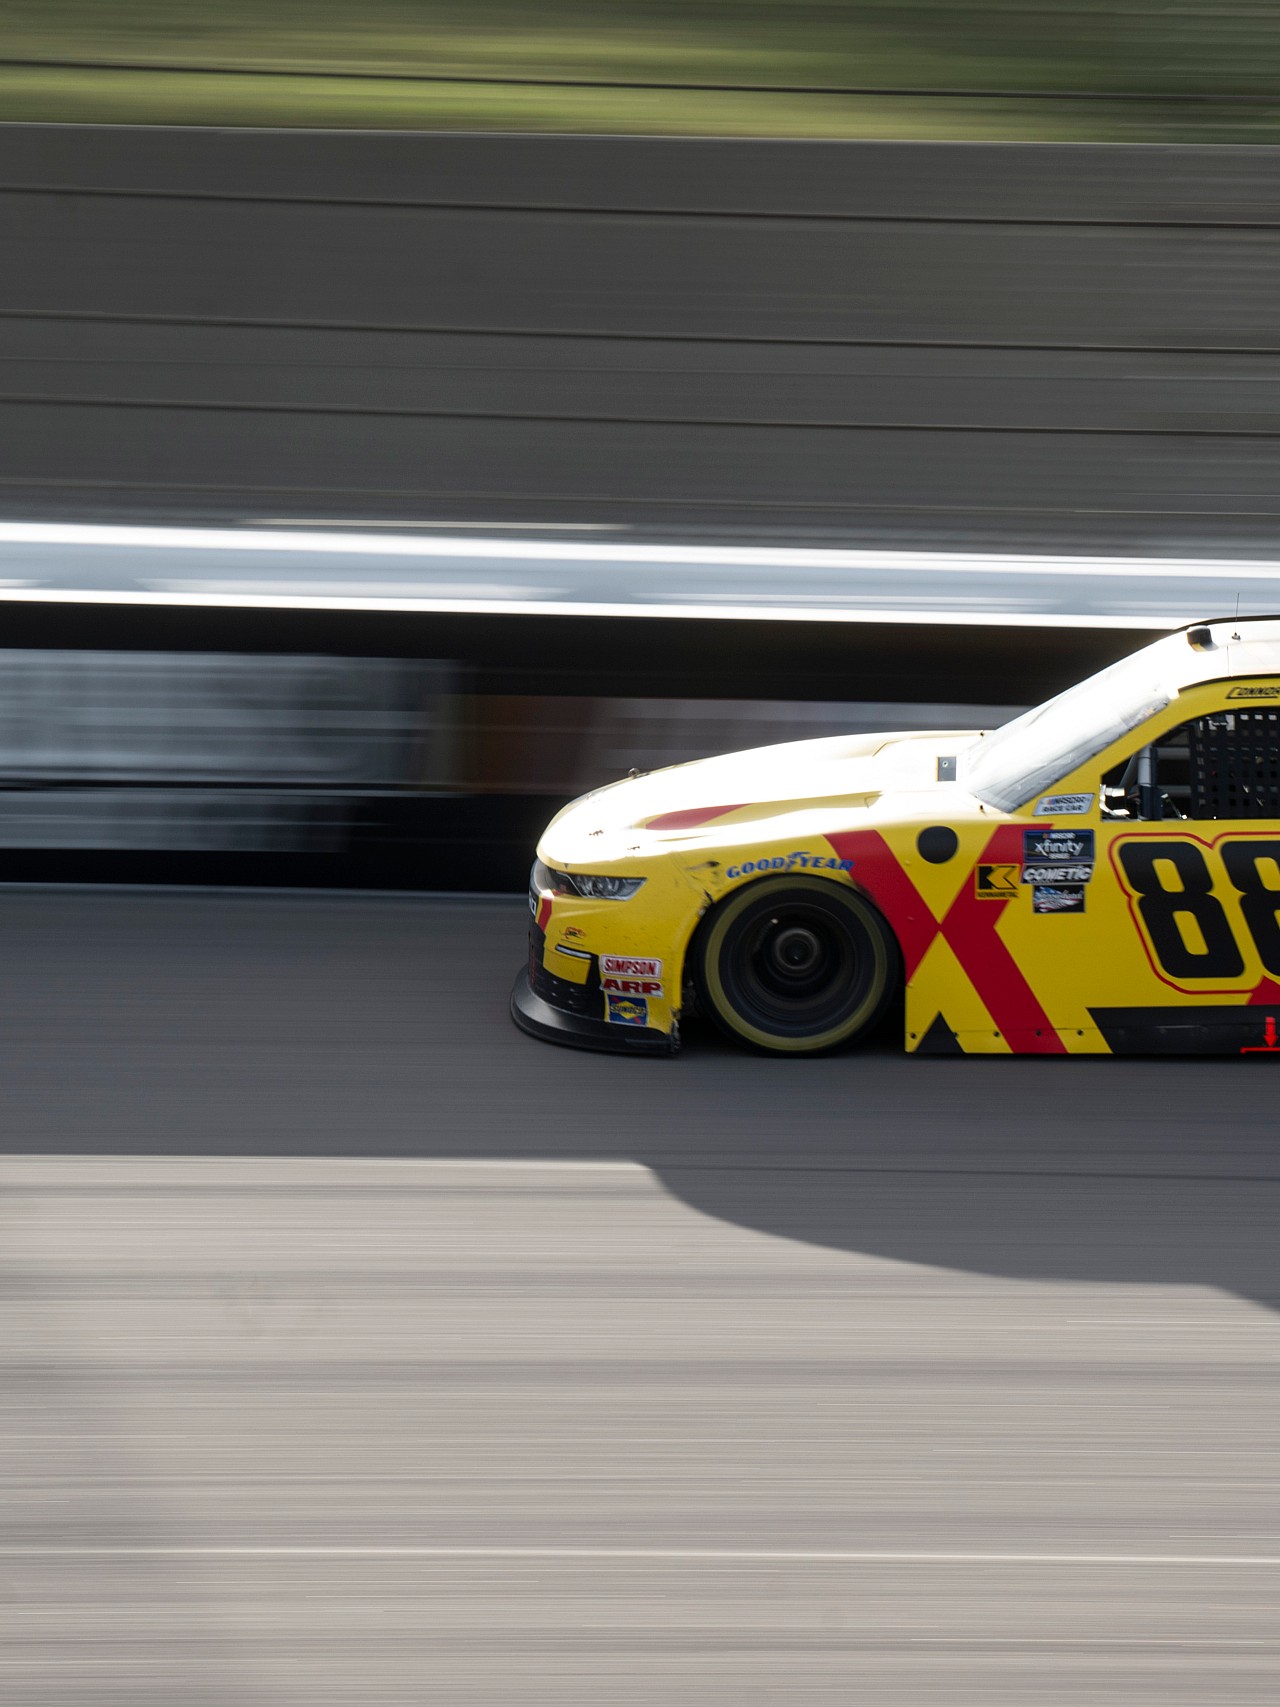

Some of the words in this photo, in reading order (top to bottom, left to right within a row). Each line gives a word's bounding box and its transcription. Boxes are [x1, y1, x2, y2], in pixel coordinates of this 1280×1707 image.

[1034, 840, 1084, 857] xfinity
[726, 852, 855, 878] GOODYEAR
[1022, 866, 1093, 881] COMETIC
[605, 958, 656, 976] SIMPSON
[603, 978, 662, 994] ARP
